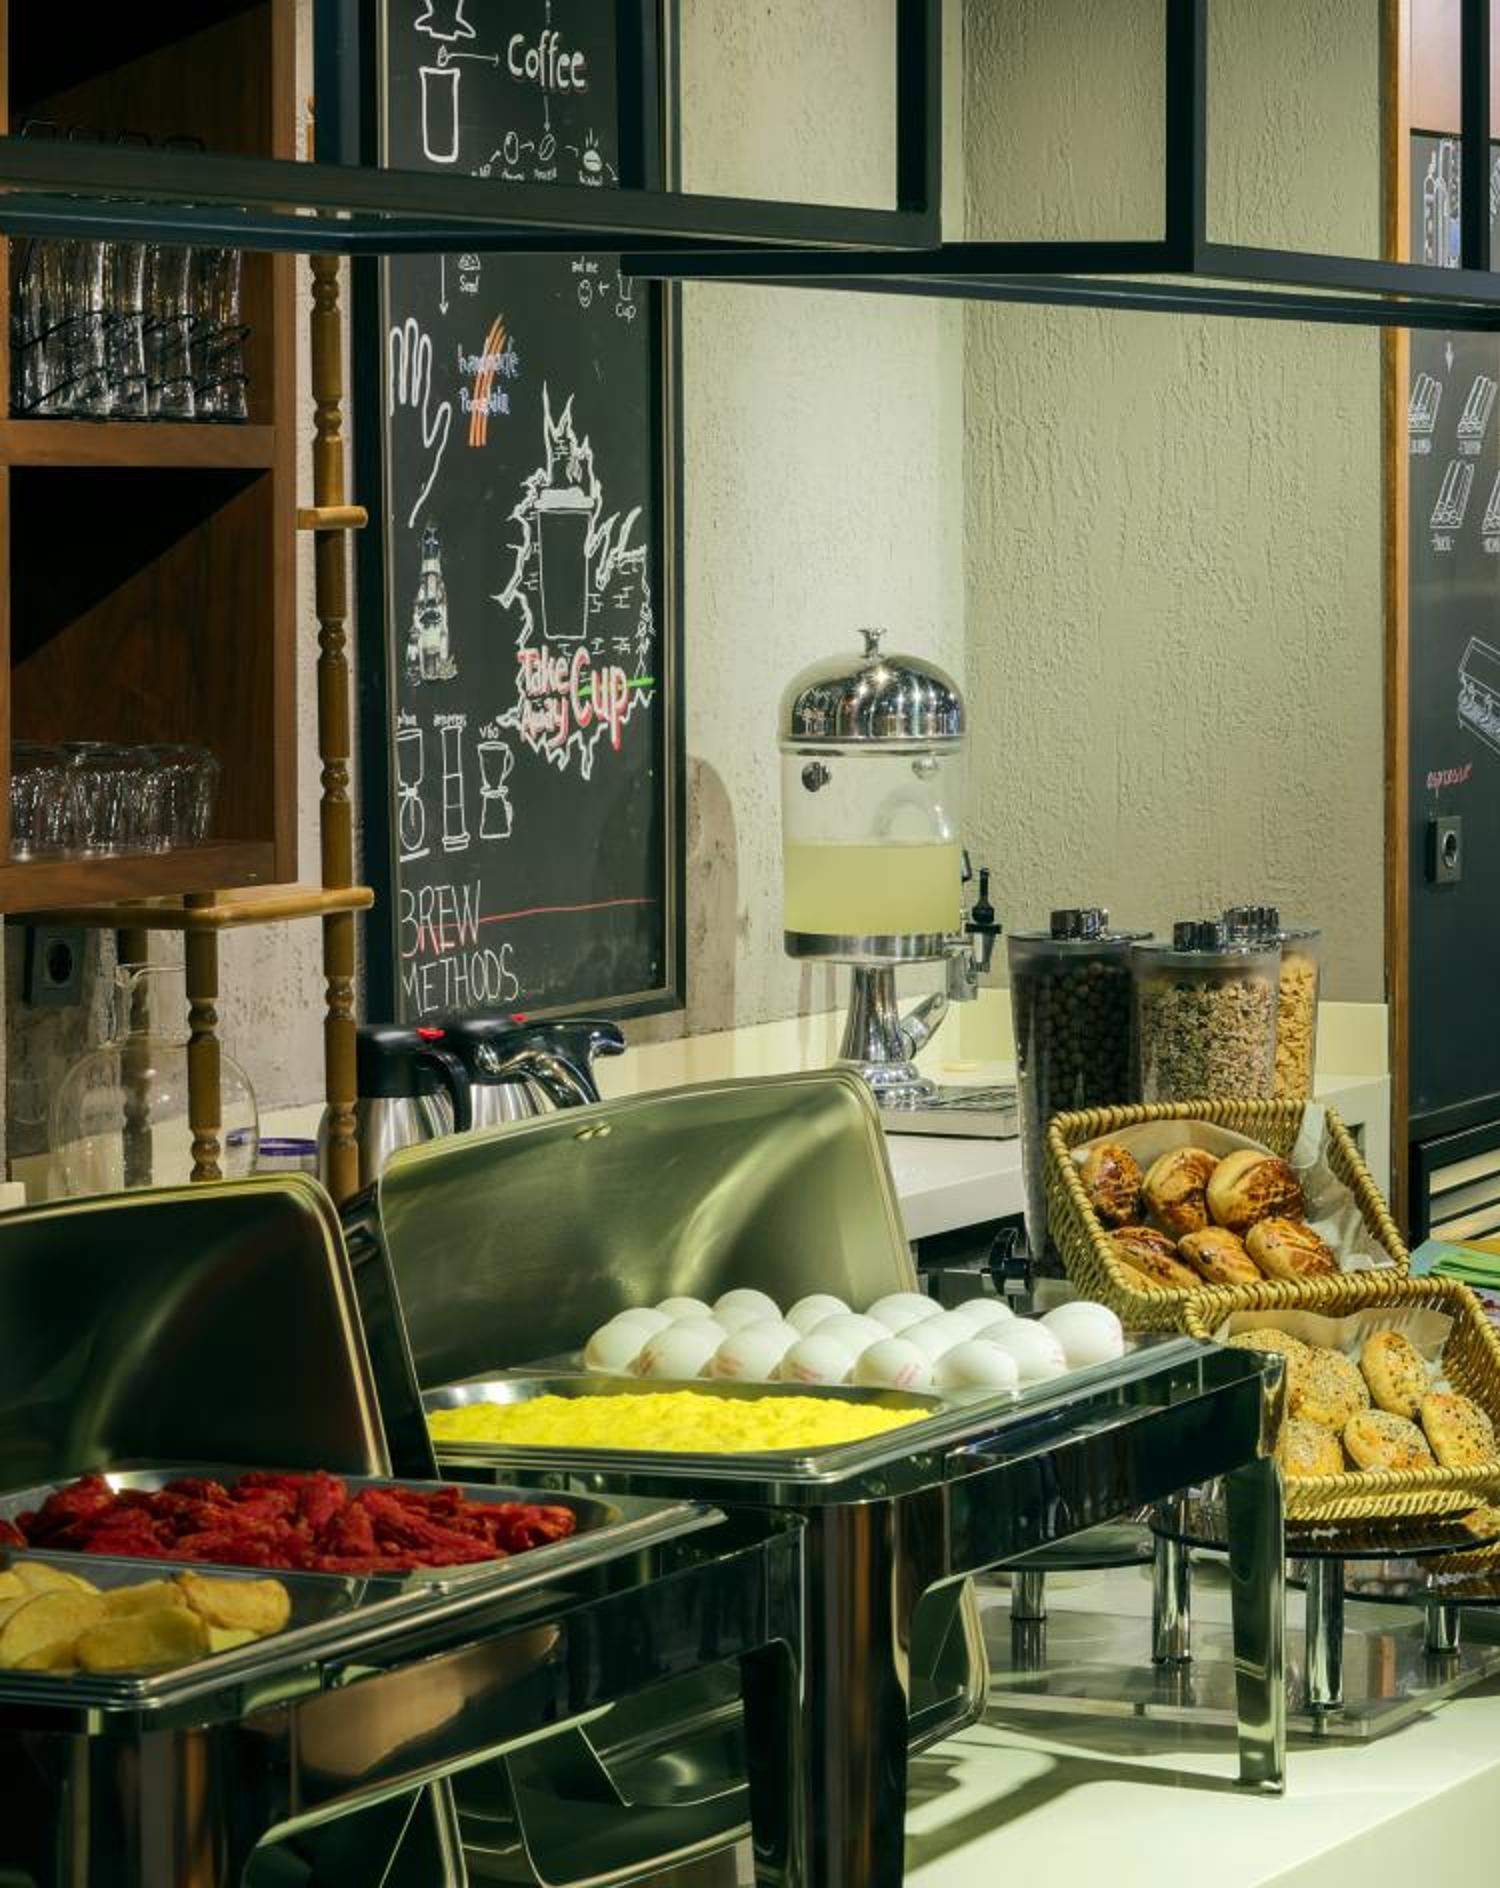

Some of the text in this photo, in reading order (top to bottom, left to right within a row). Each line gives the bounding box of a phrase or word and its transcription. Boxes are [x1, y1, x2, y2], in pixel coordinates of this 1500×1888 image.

[507, 29, 586, 89] Coffee
[517, 643, 570, 697] Take
[570, 646, 629, 752] Cup
[399, 879, 481, 958] BREW
[401, 943, 519, 1017] METHODS
